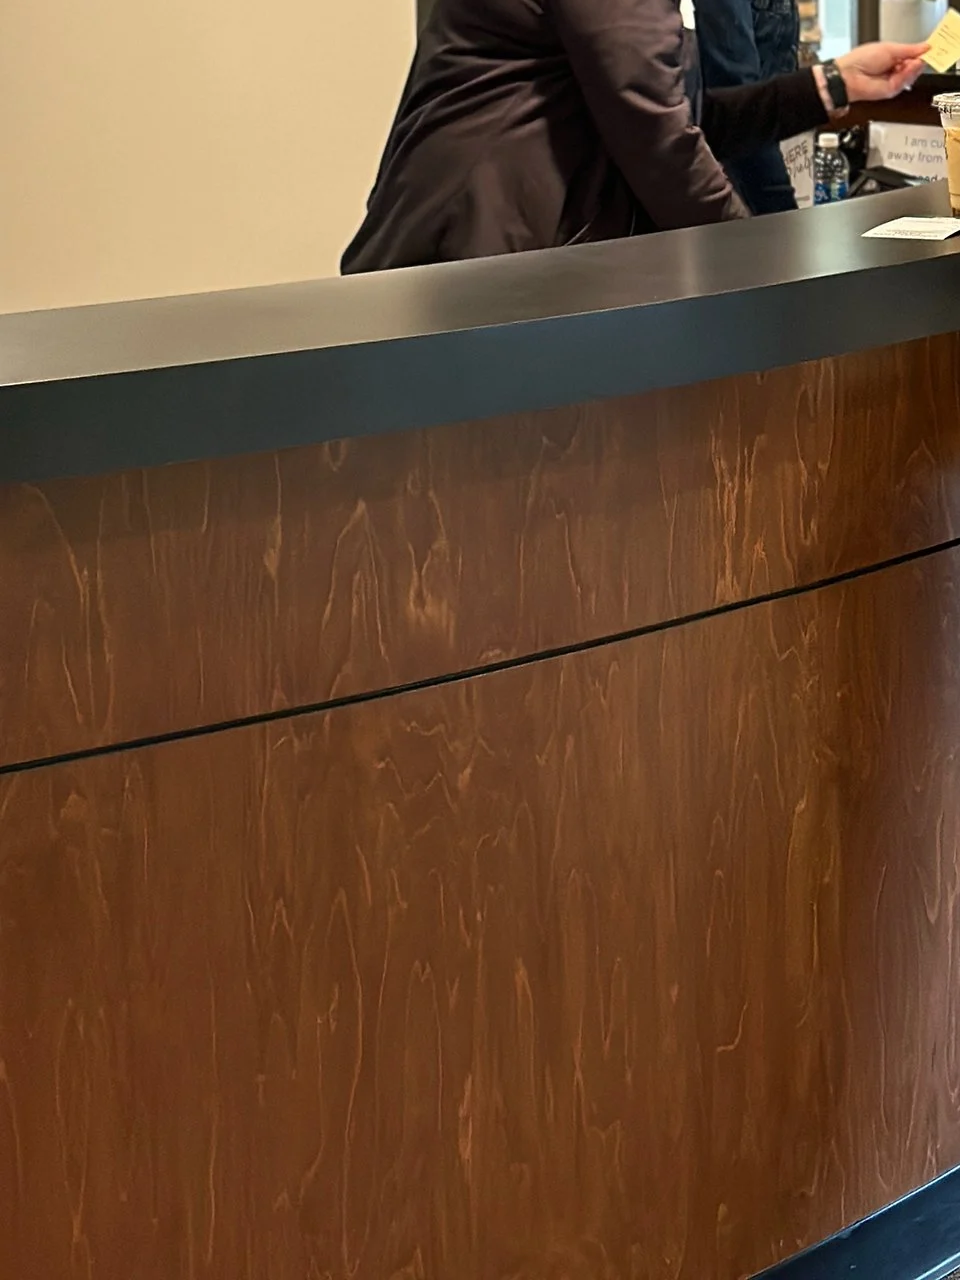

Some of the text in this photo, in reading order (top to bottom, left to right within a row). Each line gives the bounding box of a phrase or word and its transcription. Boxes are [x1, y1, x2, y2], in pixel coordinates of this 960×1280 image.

[911, 138, 928, 148] am
[887, 151, 943, 164] away from
